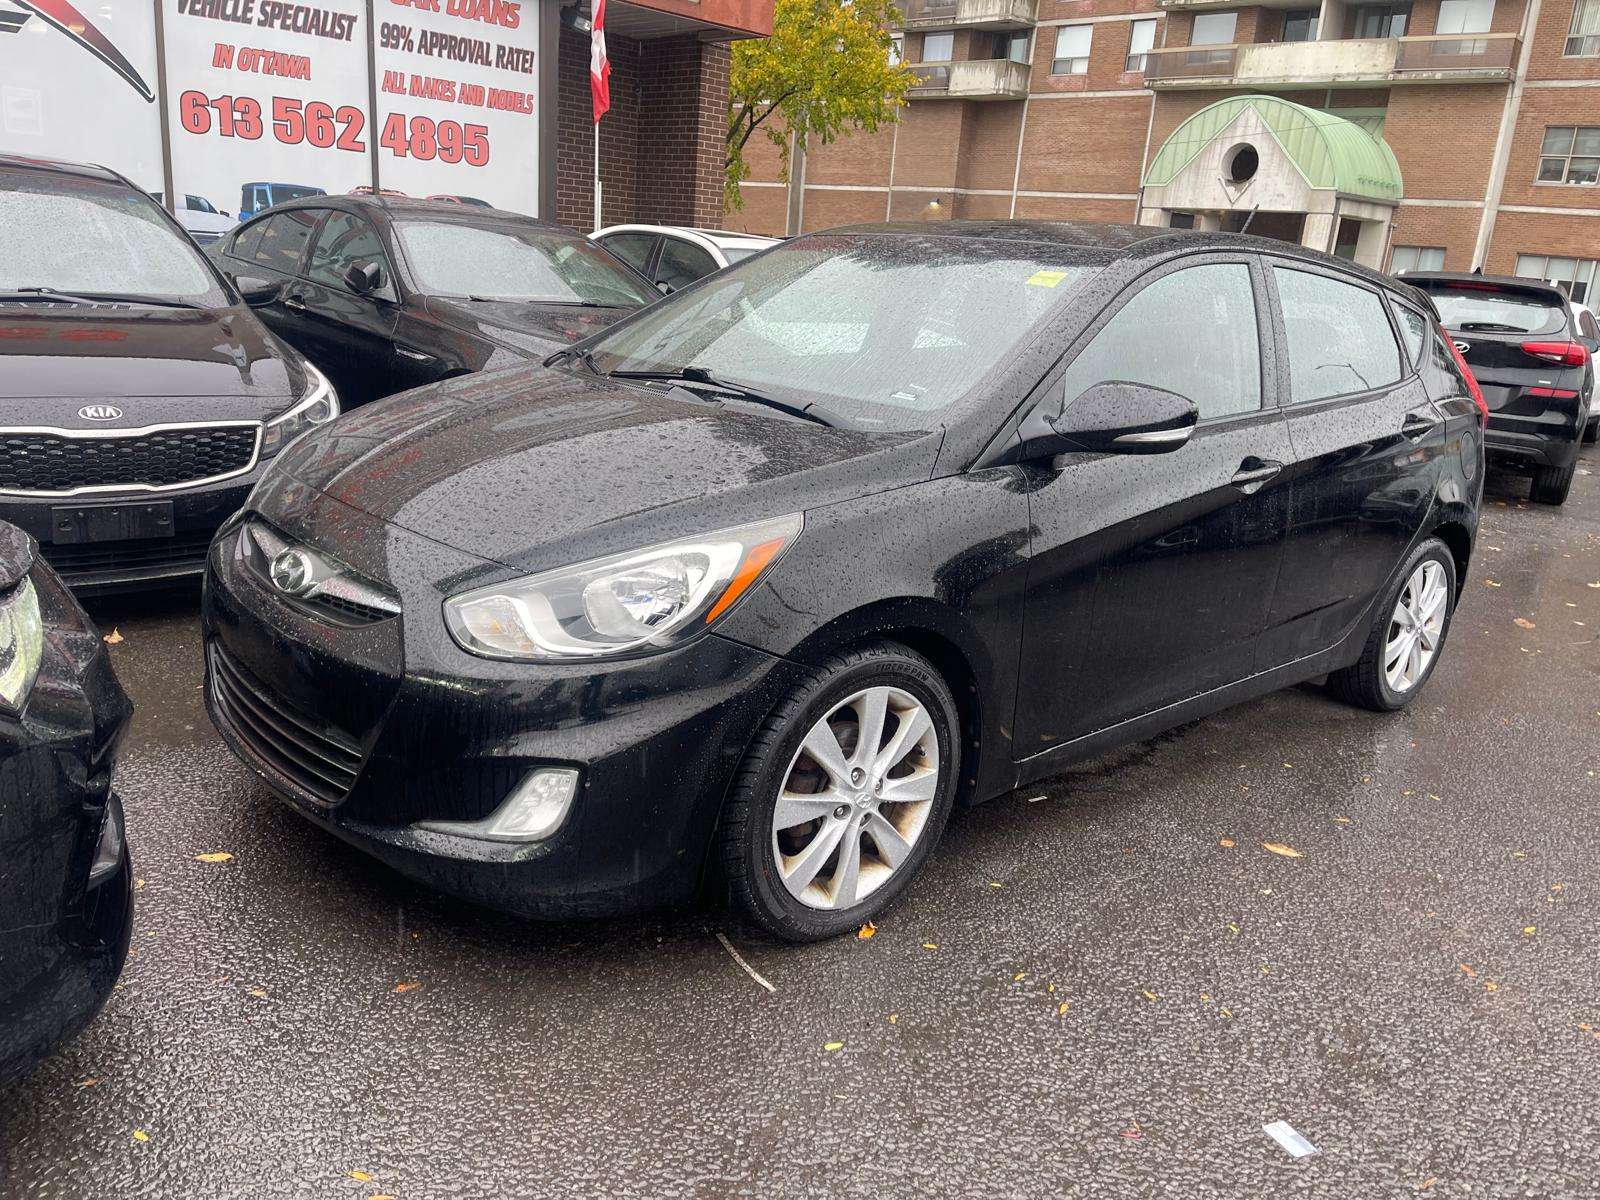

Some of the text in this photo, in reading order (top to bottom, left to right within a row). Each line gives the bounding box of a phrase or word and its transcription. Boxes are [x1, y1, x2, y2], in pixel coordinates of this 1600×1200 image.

[177, 0, 358, 41] VEHICLE SPECIALIST
[446, 0, 521, 29] LOANS
[212, 43, 311, 80] IN OTTAWA
[380, 22, 535, 74] 99% APPROVAL RATE!
[382, 70, 534, 114] ALL MAKES AND MODELS
[180, 90, 490, 167] 613 562 4895
[83, 406, 119, 418] KIA
